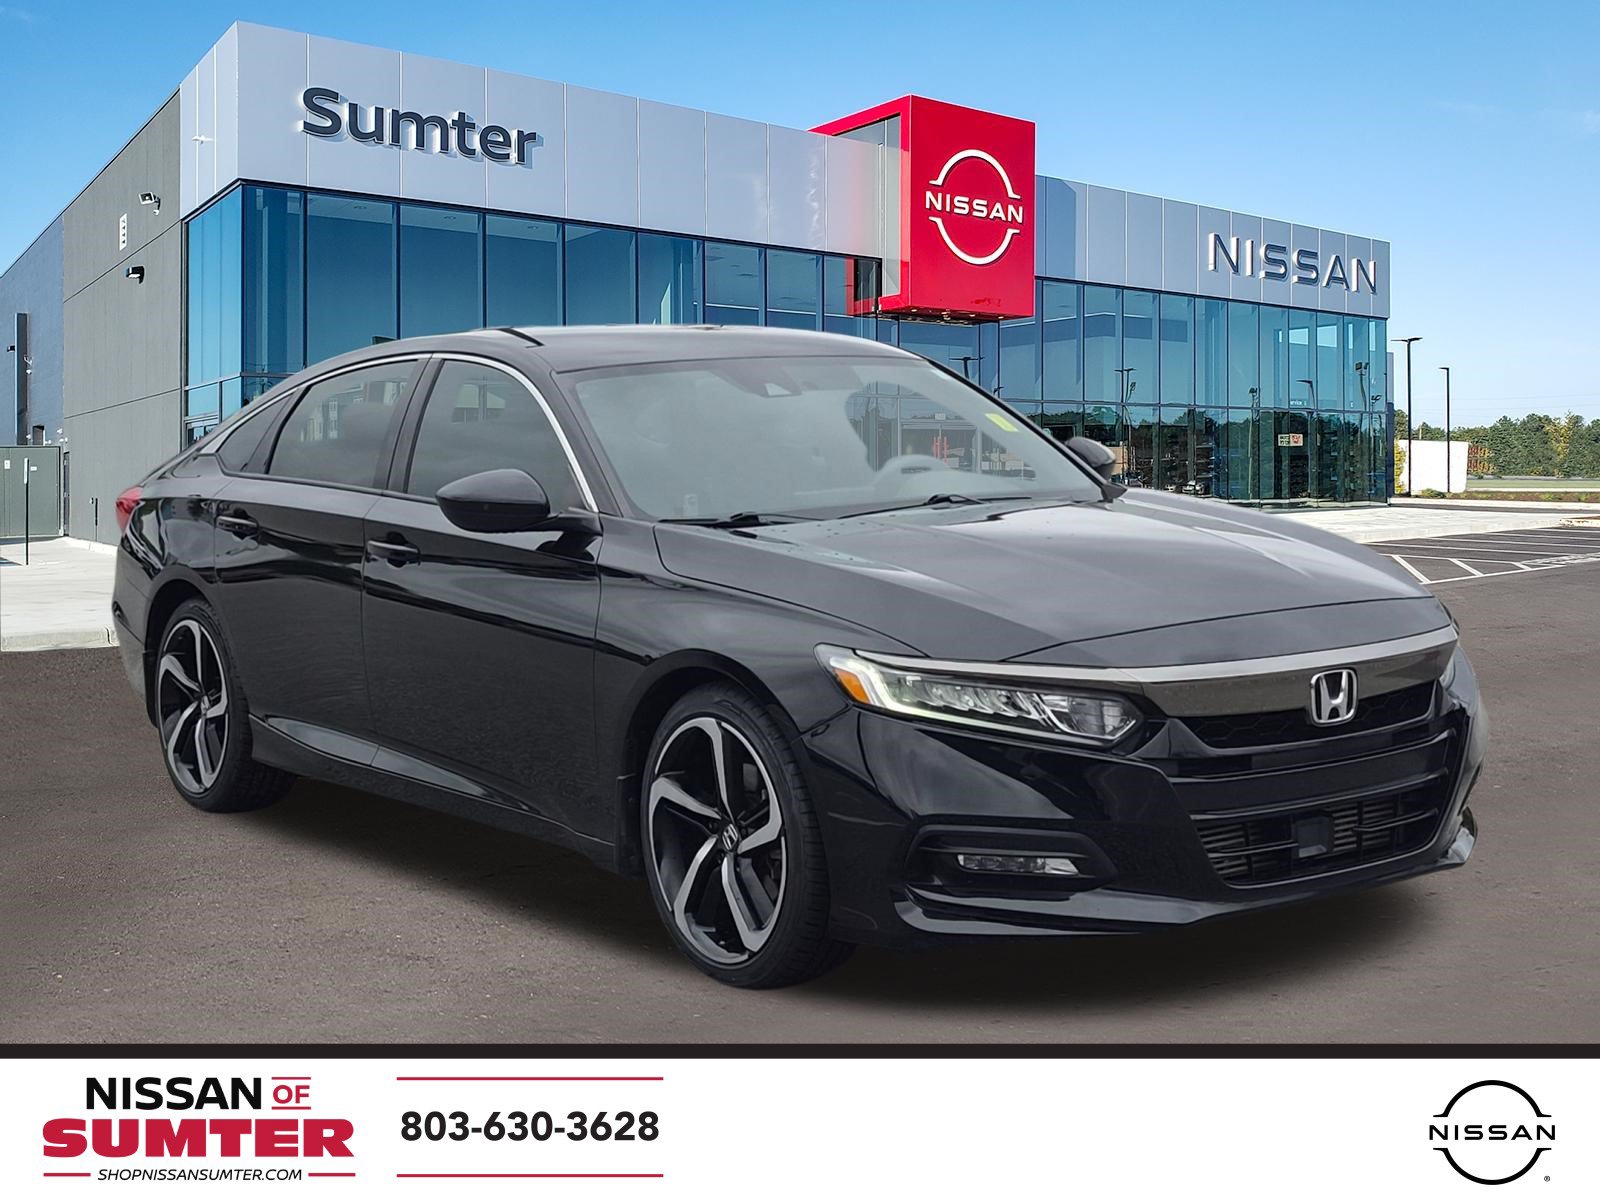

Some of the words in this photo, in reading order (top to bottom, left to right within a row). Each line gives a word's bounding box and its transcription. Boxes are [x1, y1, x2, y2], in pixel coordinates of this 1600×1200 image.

[301, 86, 538, 166] Sumter
[925, 190, 1024, 224] NISSAN
[1208, 232, 1378, 294] NISSAN
